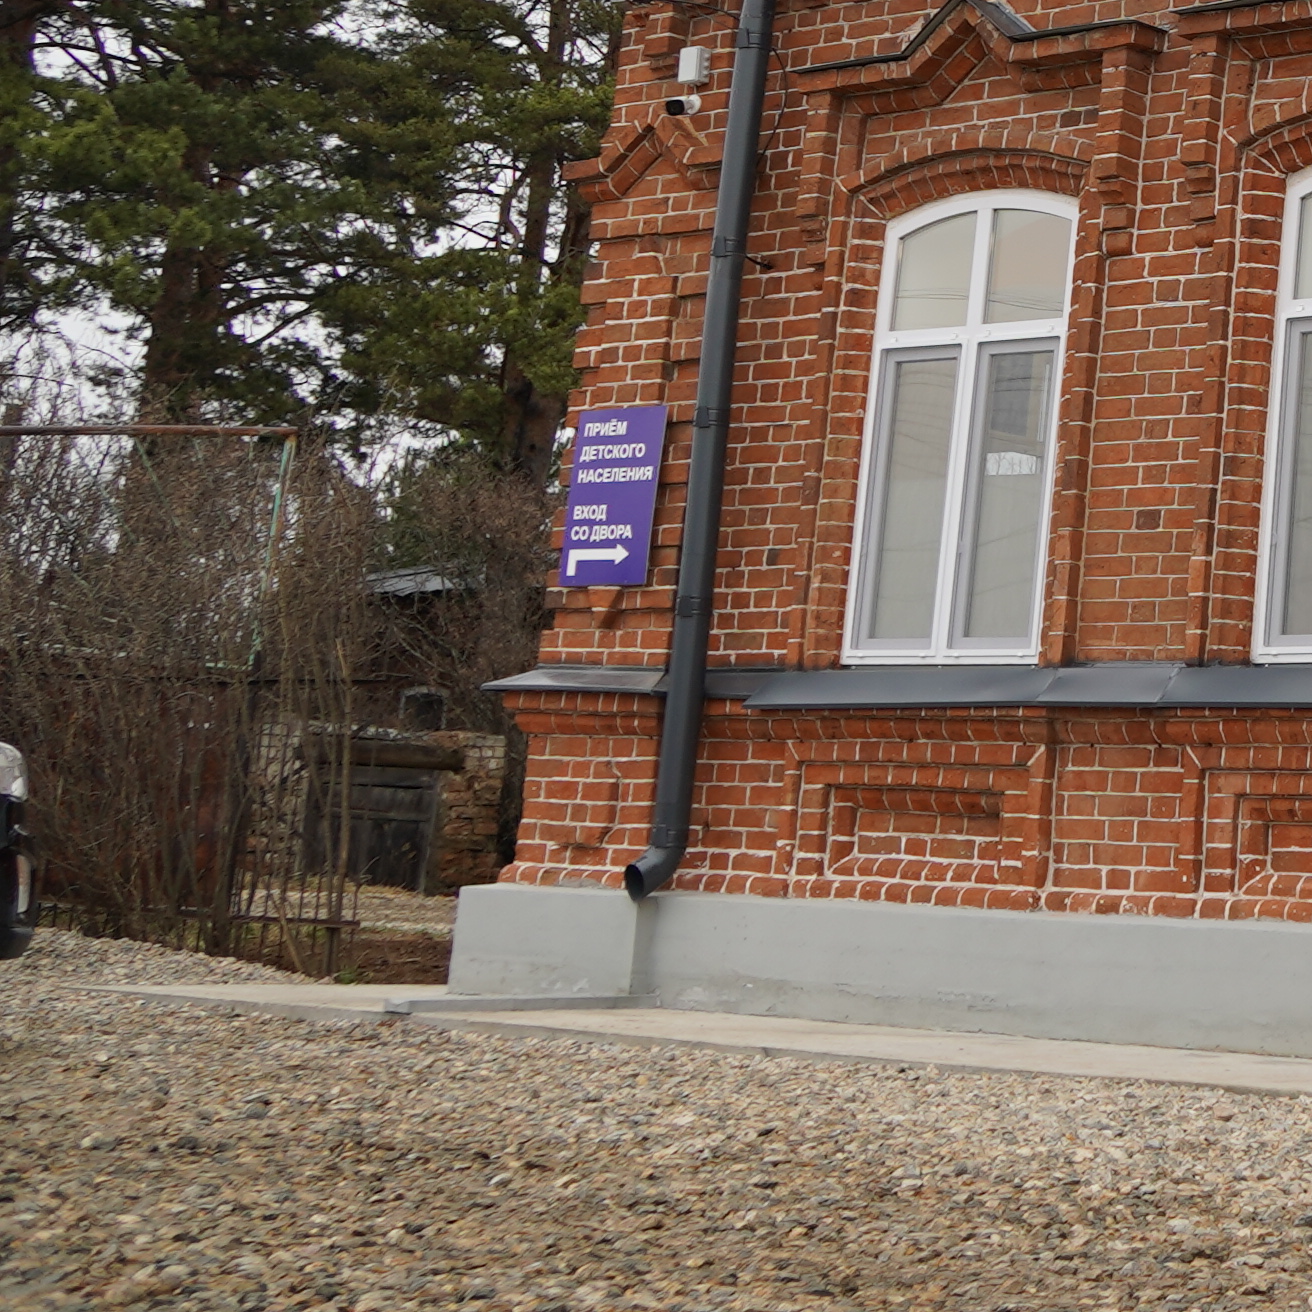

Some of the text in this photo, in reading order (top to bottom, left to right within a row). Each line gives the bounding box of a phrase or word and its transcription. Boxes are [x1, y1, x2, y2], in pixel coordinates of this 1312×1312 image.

[583, 419, 627, 437] ПРИЁМ
[579, 443, 645, 462] ДЕТСКОГО
[577, 465, 654, 484] НАСЕЛЕНИЯ
[573, 504, 607, 521] ВХОД
[570, 525, 632, 542] СО ДВОРА
